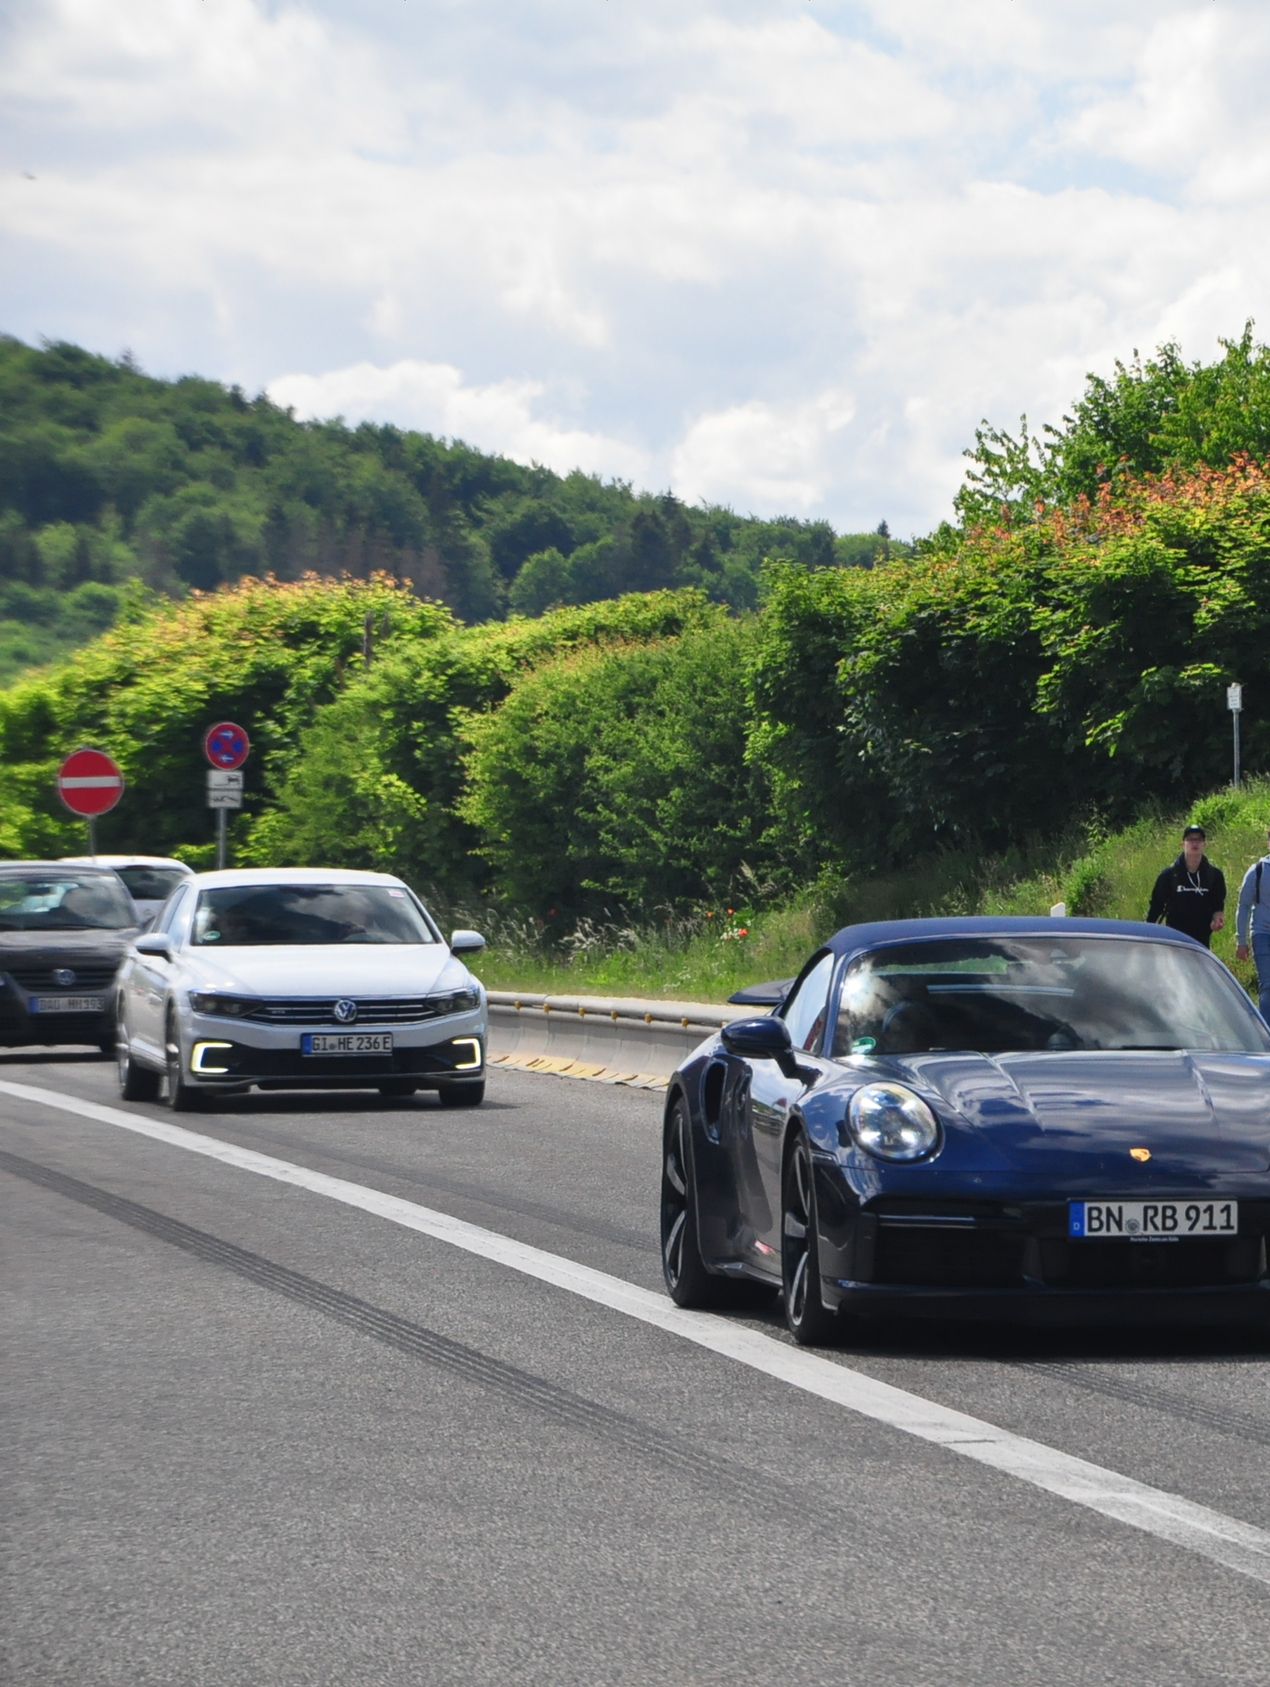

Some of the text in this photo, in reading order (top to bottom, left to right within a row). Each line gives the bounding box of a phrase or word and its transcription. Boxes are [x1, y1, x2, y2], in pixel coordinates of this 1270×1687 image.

[312, 1037, 328, 1051] GI
[338, 1037, 354, 1050] HE
[356, 1036, 381, 1050] 236
[1087, 1203, 1235, 1233] BN RB 911
[1073, 1222, 1080, 1231] D
